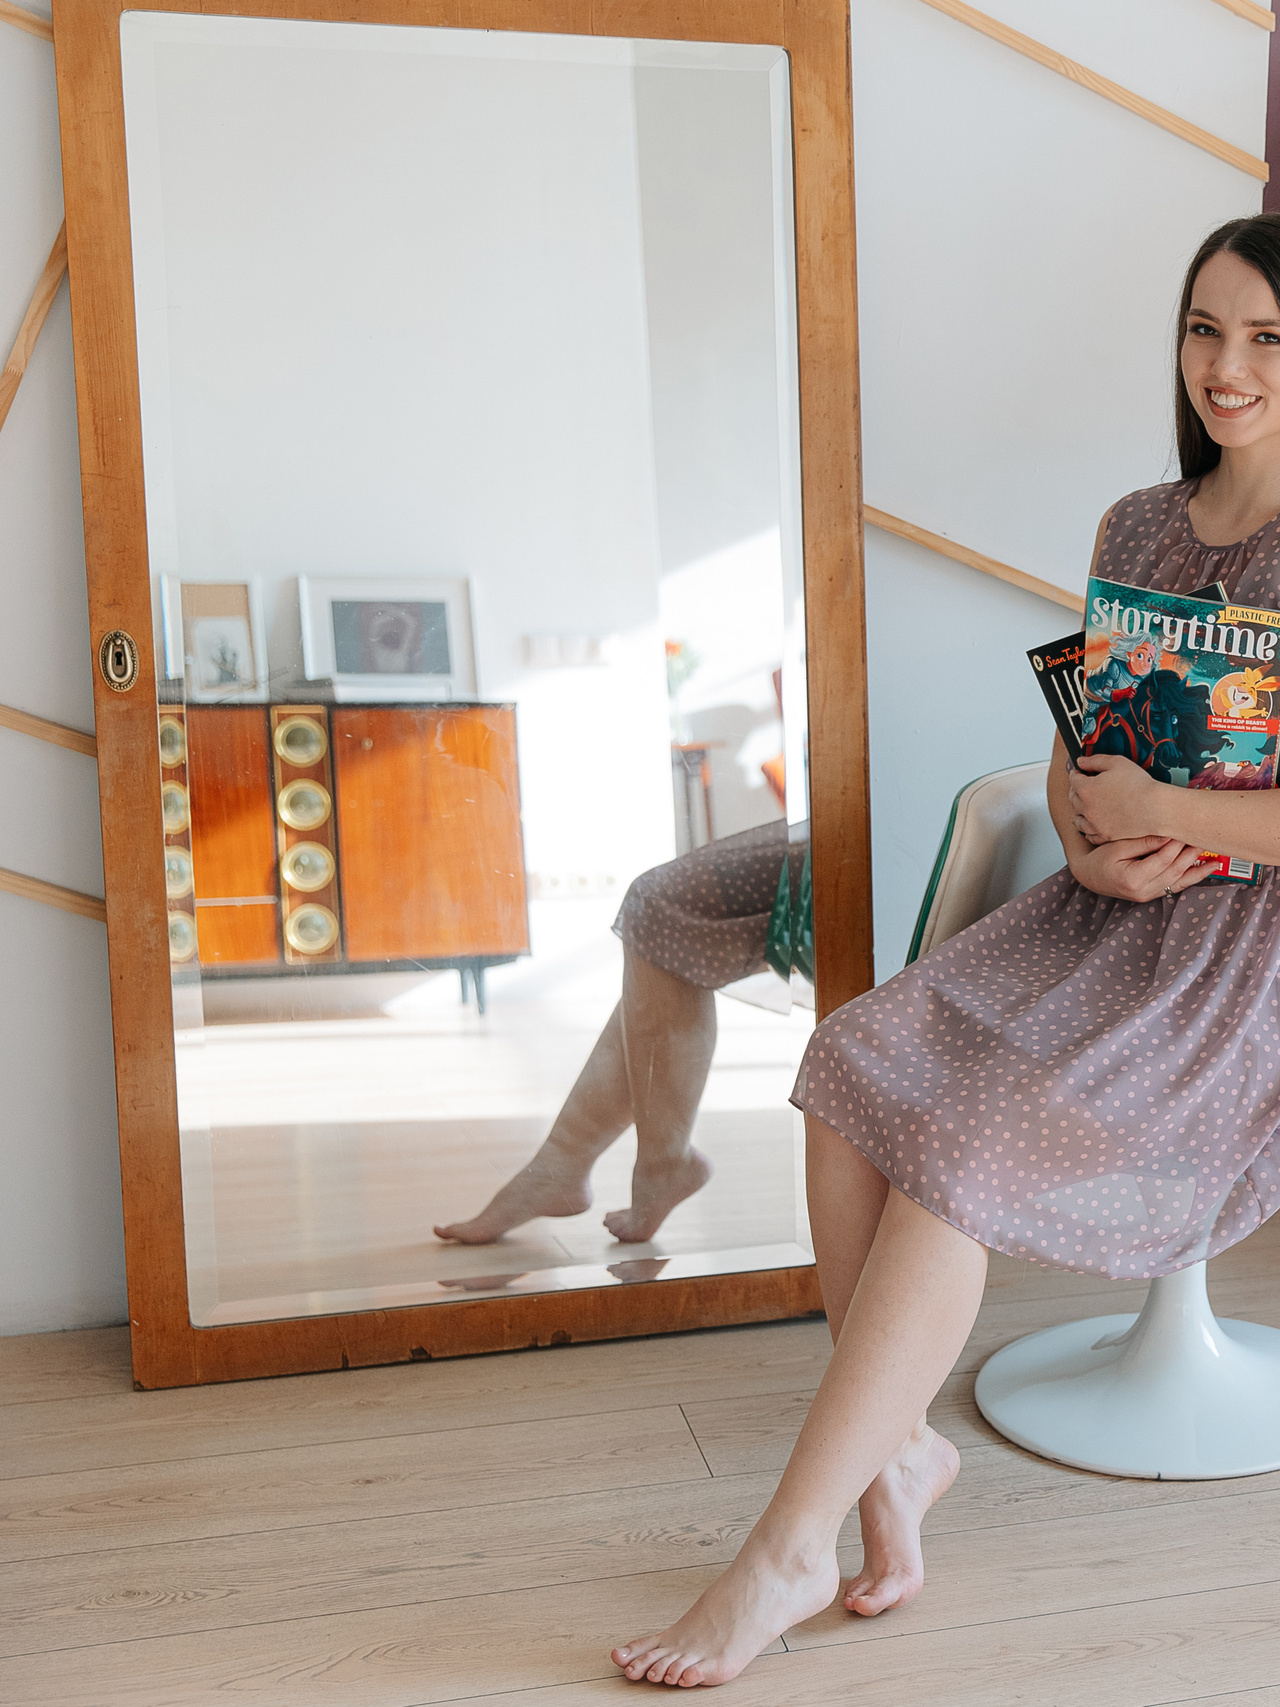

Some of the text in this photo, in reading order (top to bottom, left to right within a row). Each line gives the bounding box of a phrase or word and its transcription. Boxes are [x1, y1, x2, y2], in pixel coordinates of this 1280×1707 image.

[1230, 609, 1264, 622] PLASTIC
[1091, 597, 1278, 661] Storytime
[1045, 655, 1067, 668] Sean
